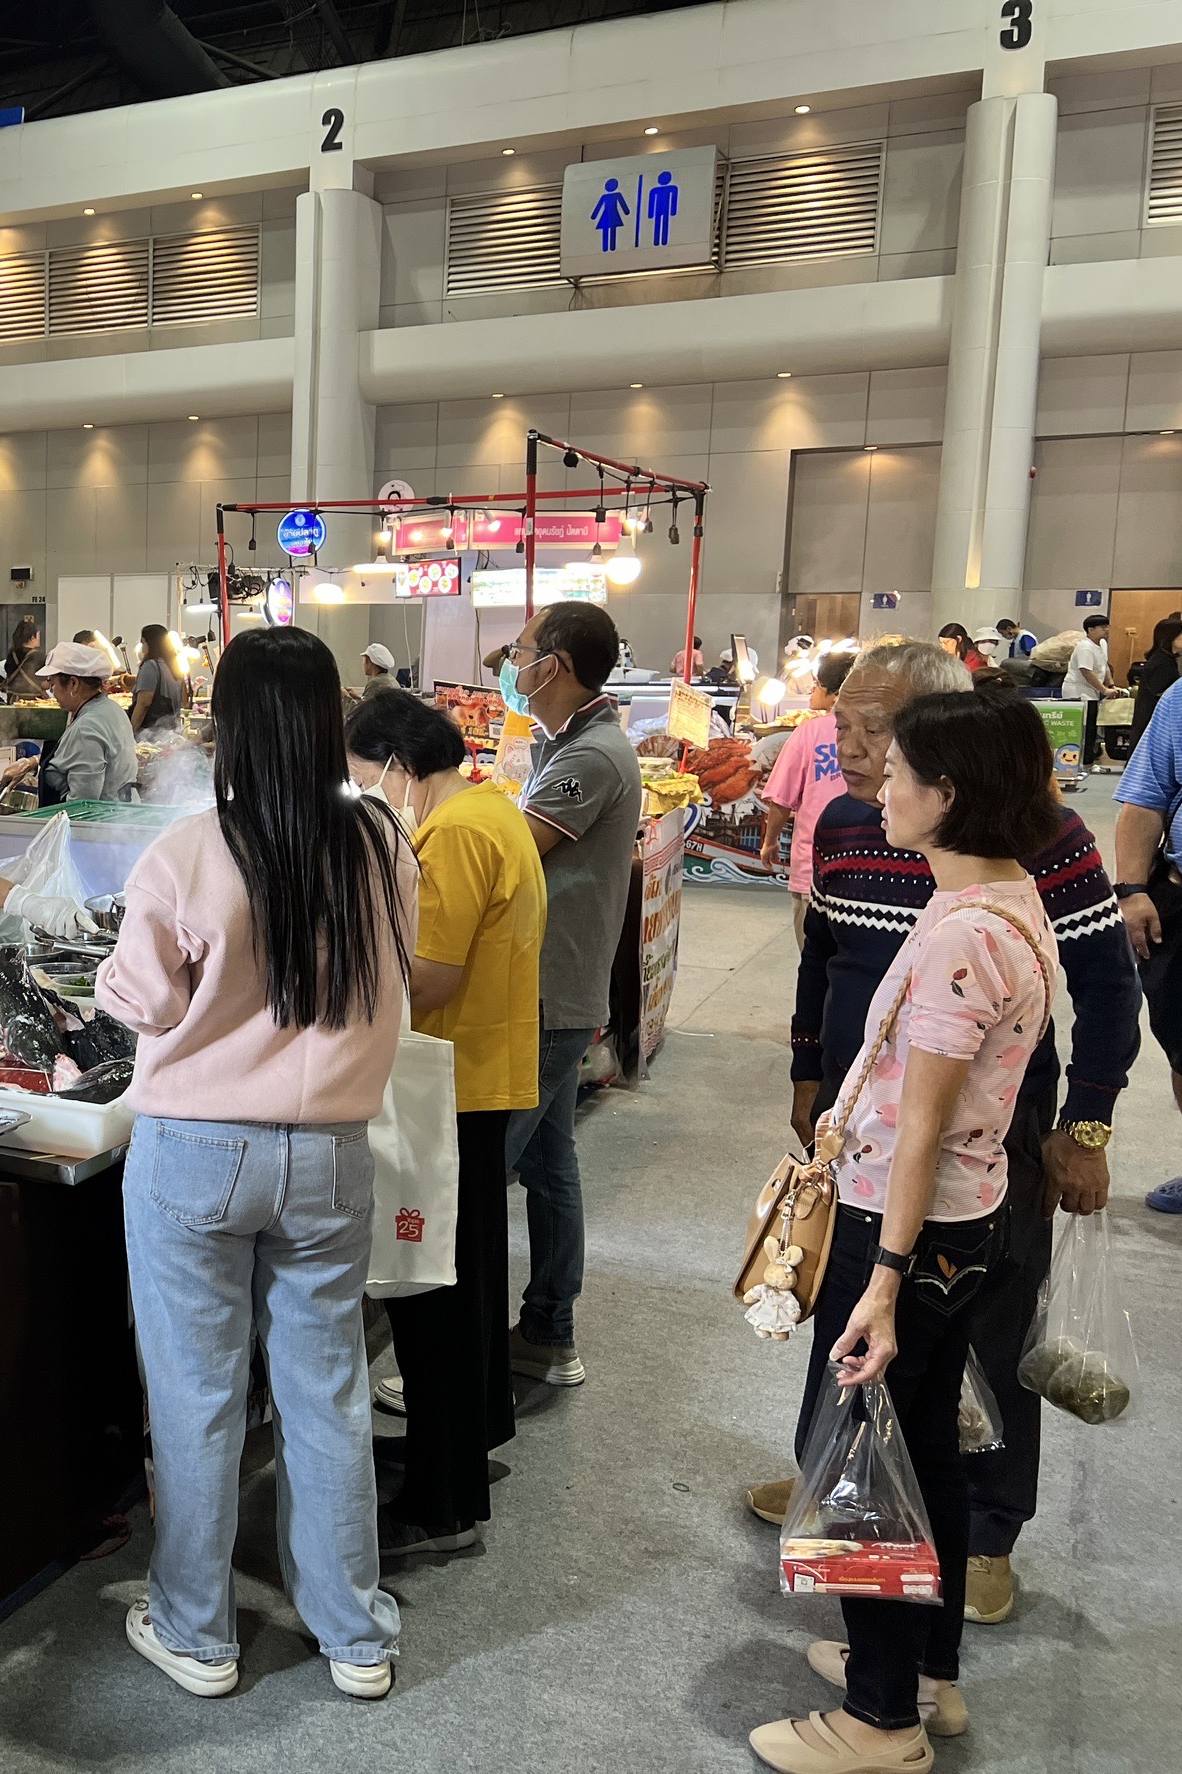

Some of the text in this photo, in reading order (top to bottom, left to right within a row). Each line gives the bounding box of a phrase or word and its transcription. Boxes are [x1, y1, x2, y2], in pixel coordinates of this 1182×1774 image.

[1000, 0, 1033, 49] 3
[321, 107, 345, 153] 2
[398, 1220, 419, 1238] 25
